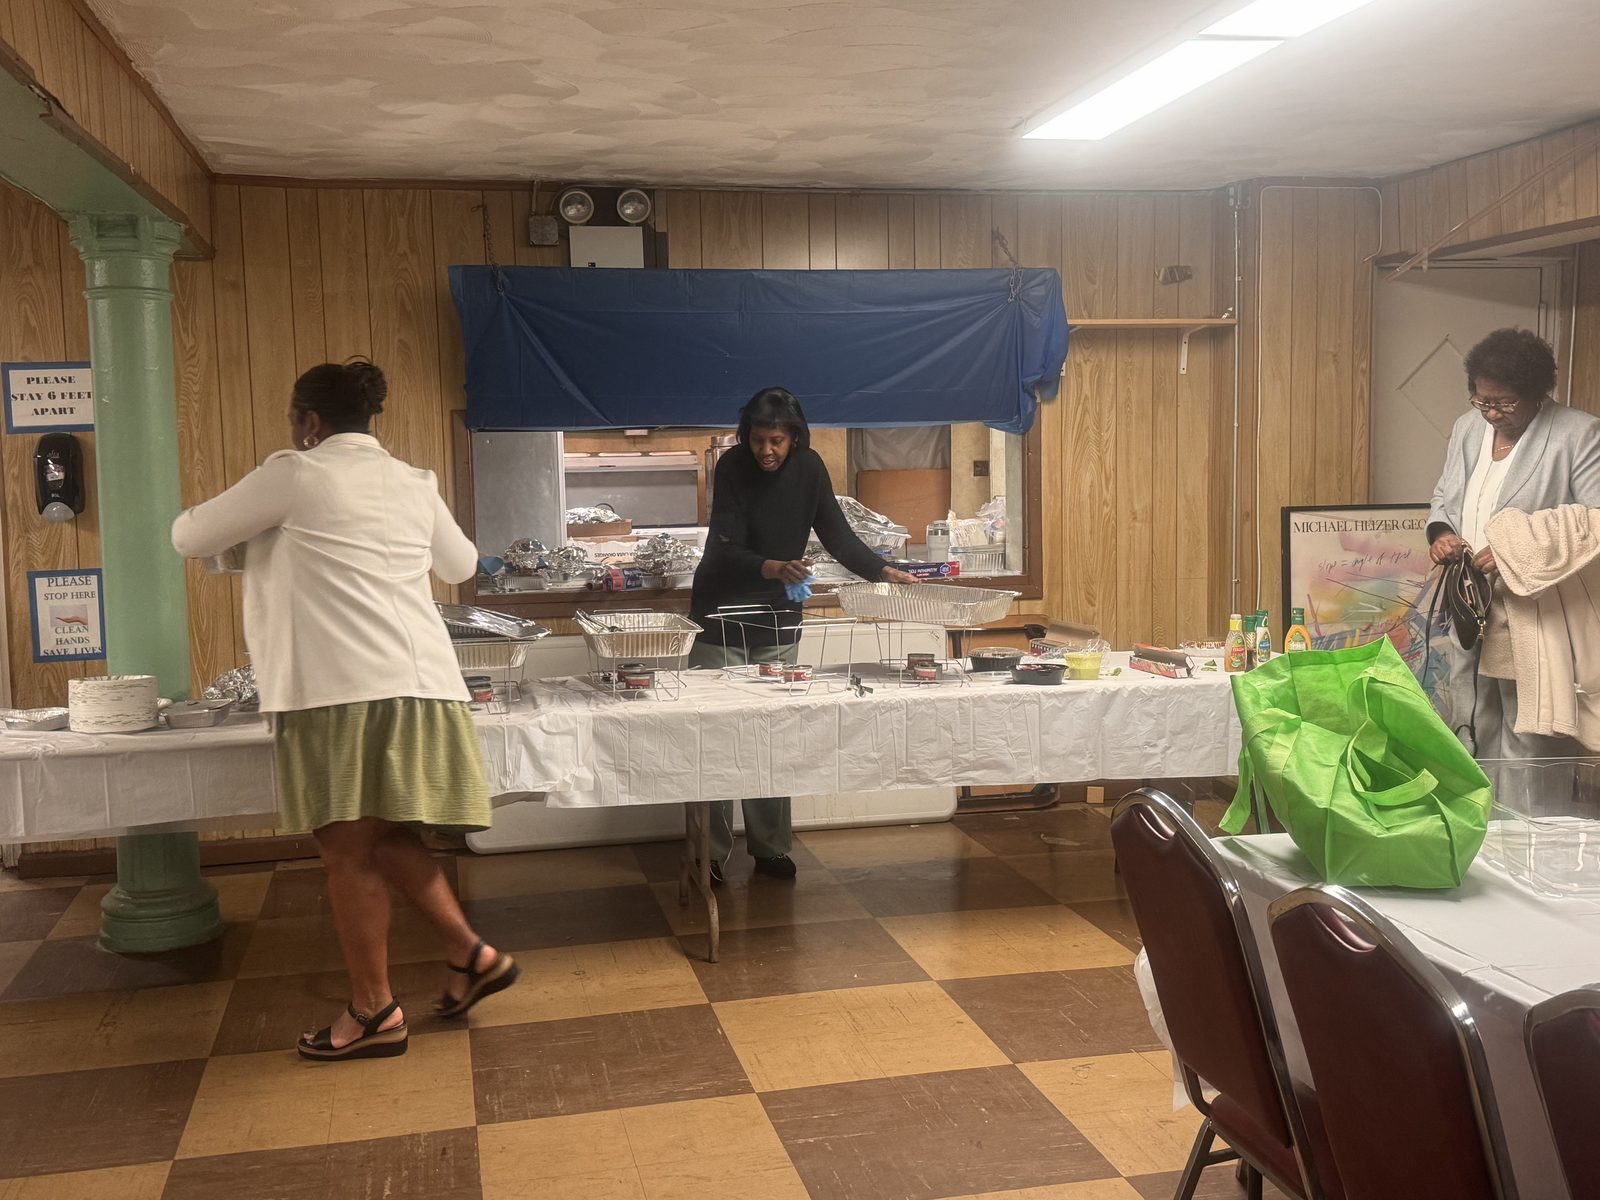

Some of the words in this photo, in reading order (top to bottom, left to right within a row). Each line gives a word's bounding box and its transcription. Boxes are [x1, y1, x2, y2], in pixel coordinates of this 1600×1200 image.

[26, 375, 76, 385] PLEASE
[11, 392, 44, 401] STAY
[47, 391, 56, 401] 6
[60, 391, 92, 400] FEET
[32, 407, 76, 416] APART
[1293, 520, 1353, 533] MICHAEL
[1354, 519, 1400, 532] HEIZER
[1402, 518, 1428, 530] GEO
[48, 576, 92, 587] PLEASE
[44, 592, 68, 600] STOP
[71, 591, 96, 599] HERE
[55, 626, 88, 634] CLEAN
[56, 637, 90, 646] HANDS
[43, 647, 70, 656] SAVE
